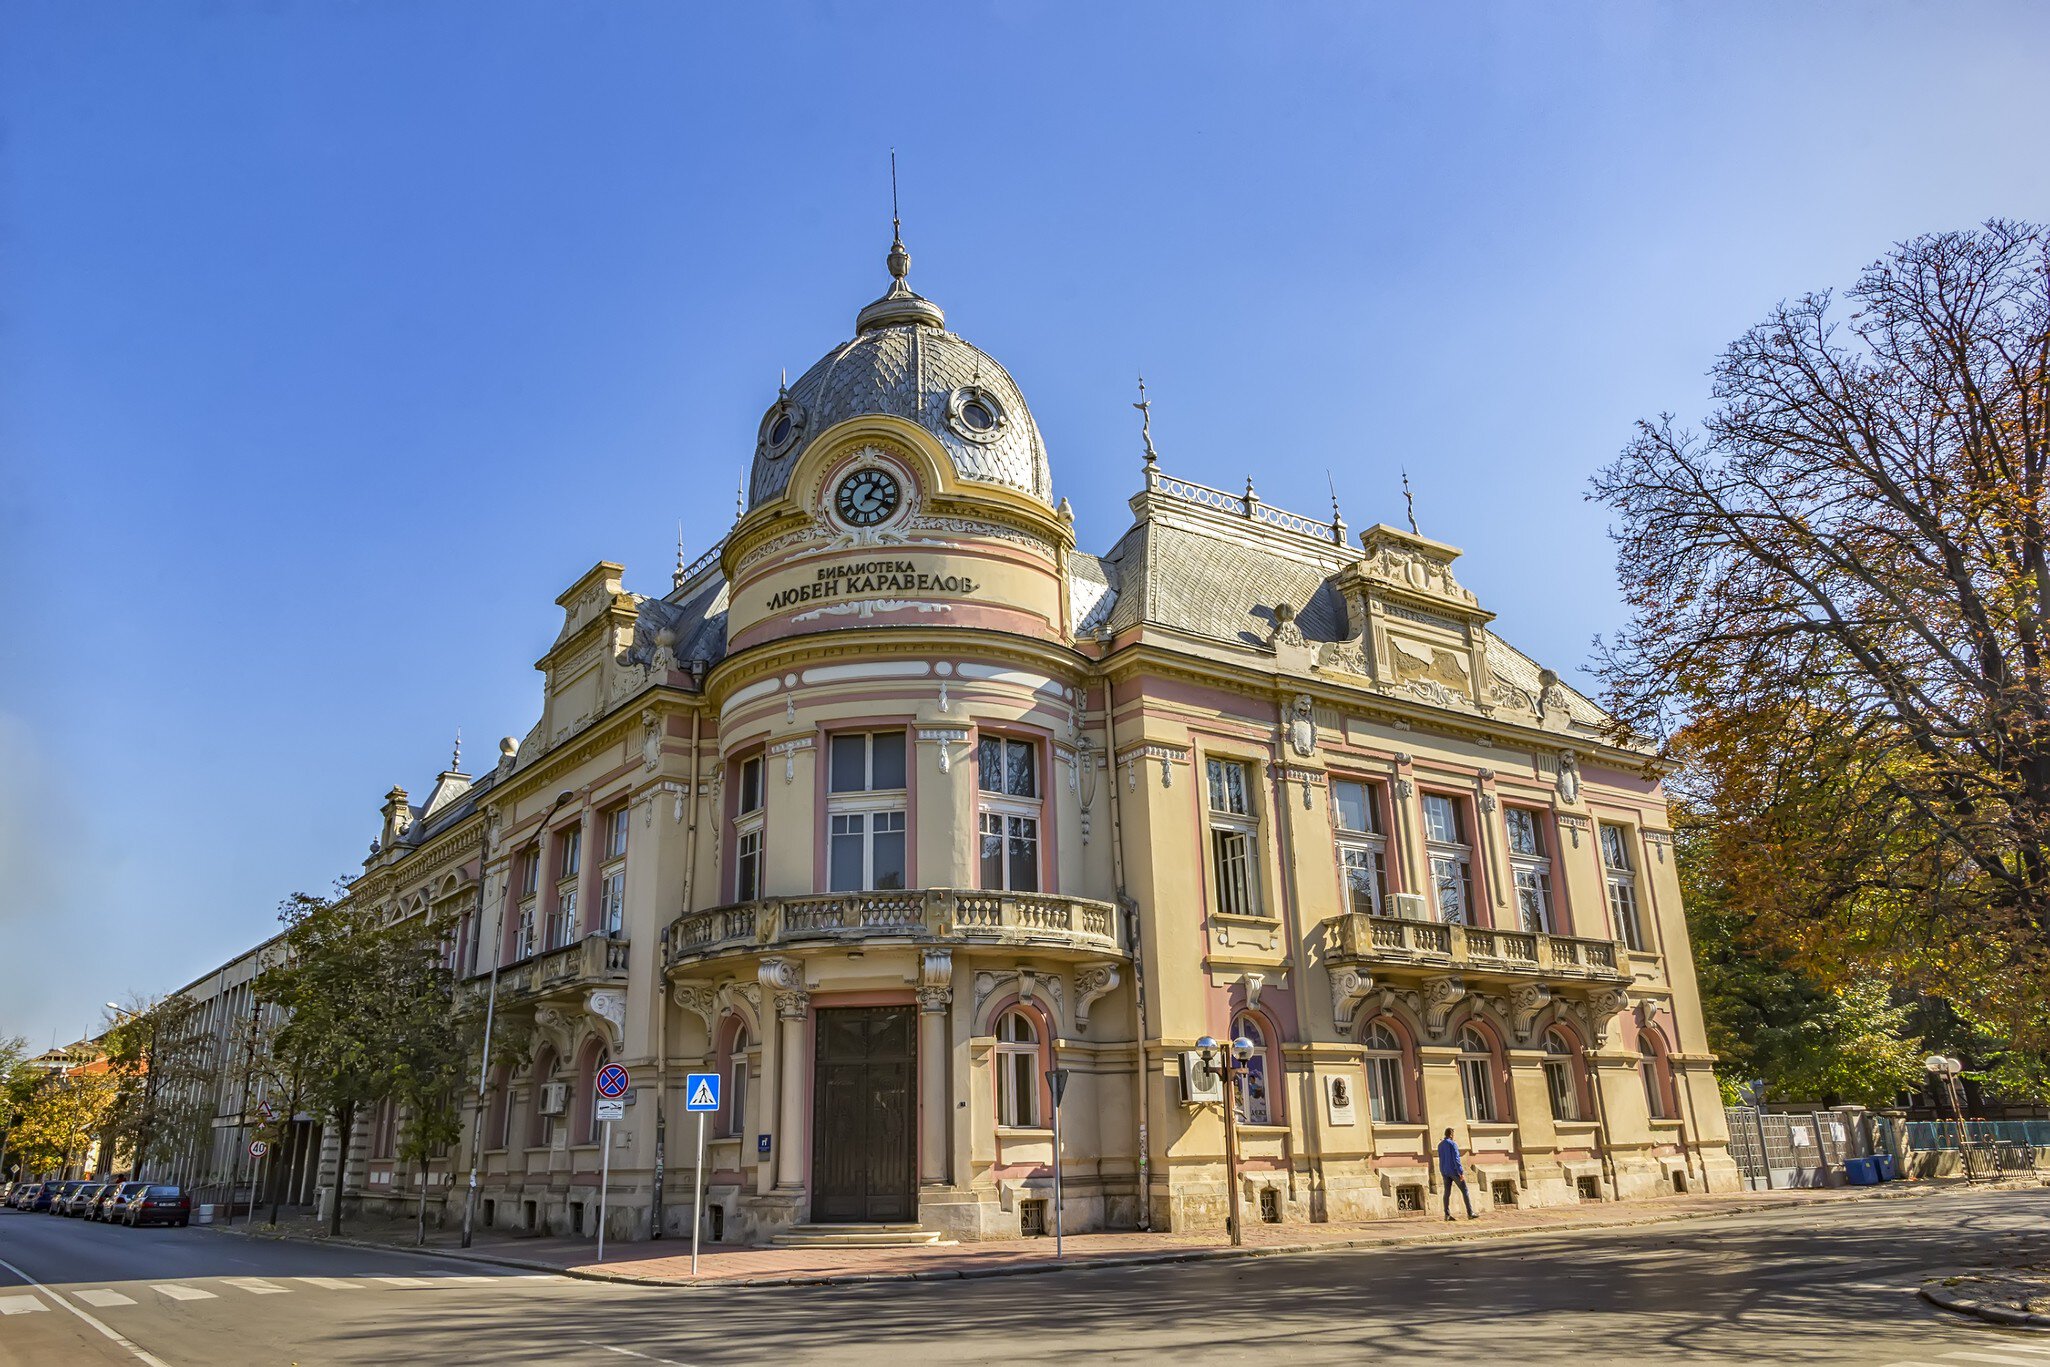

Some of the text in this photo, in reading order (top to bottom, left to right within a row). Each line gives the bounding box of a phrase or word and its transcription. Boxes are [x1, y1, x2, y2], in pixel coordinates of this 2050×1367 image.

[817, 561, 916, 581] БИБЛИОТЕКА
[846, 574, 973, 594] КАРАВЕЛОВ
[252, 1142, 265, 1153] 40
